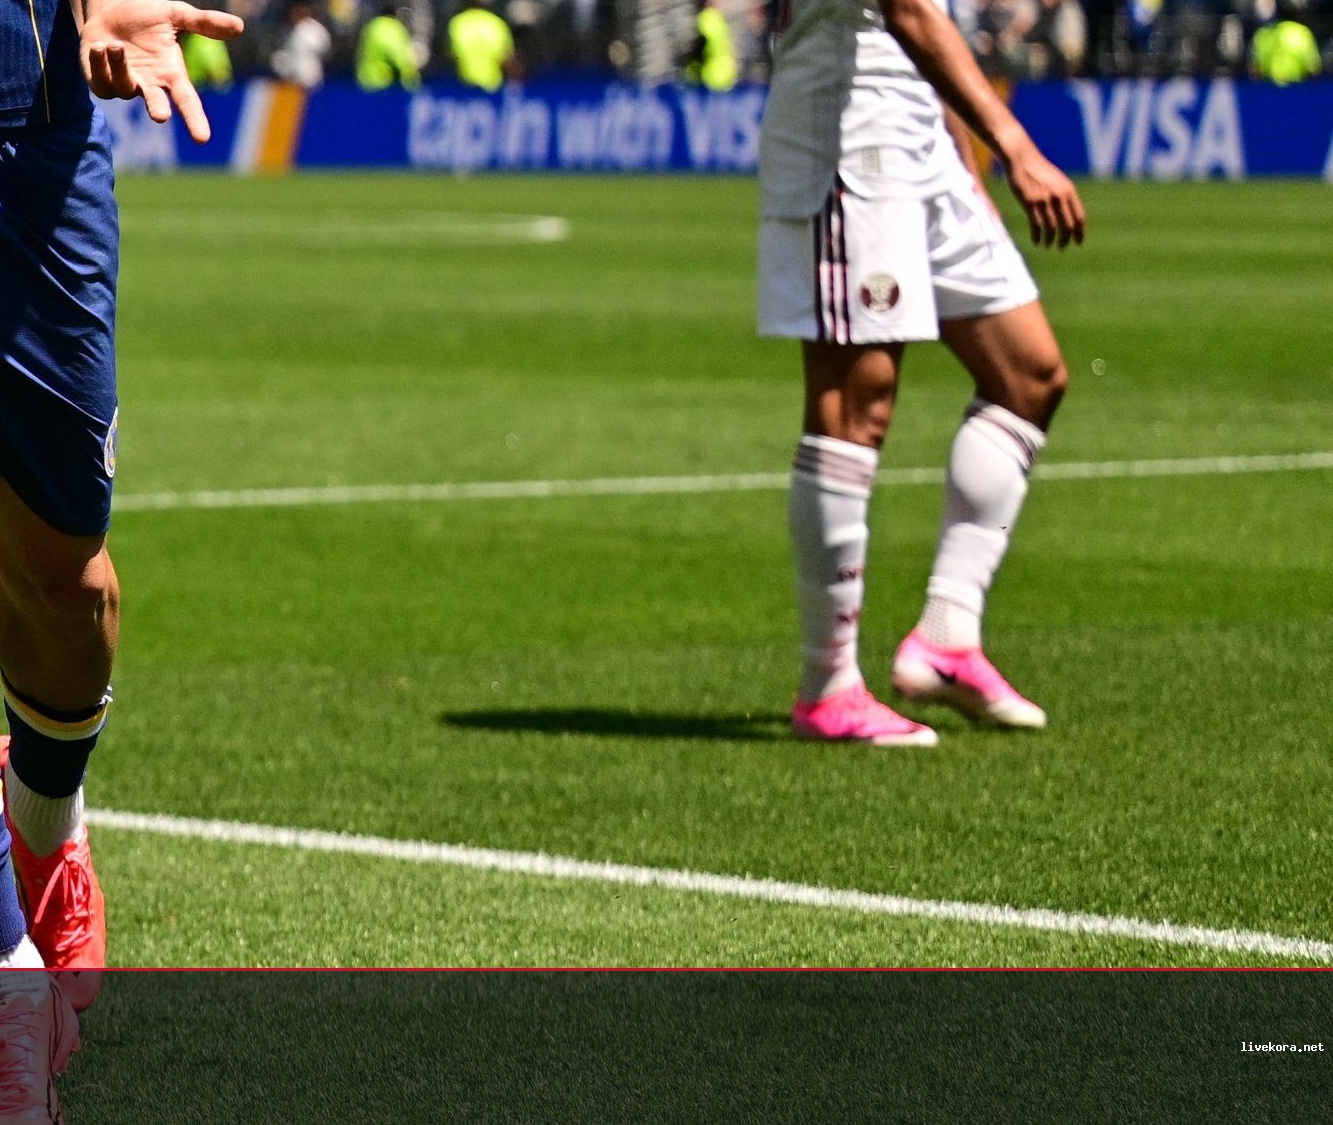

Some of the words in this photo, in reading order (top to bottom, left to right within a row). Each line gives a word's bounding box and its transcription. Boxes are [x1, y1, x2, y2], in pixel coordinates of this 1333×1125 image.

[407, 84, 500, 177] tap
[681, 82, 771, 169] VIS
[1067, 77, 1248, 182] VISA
